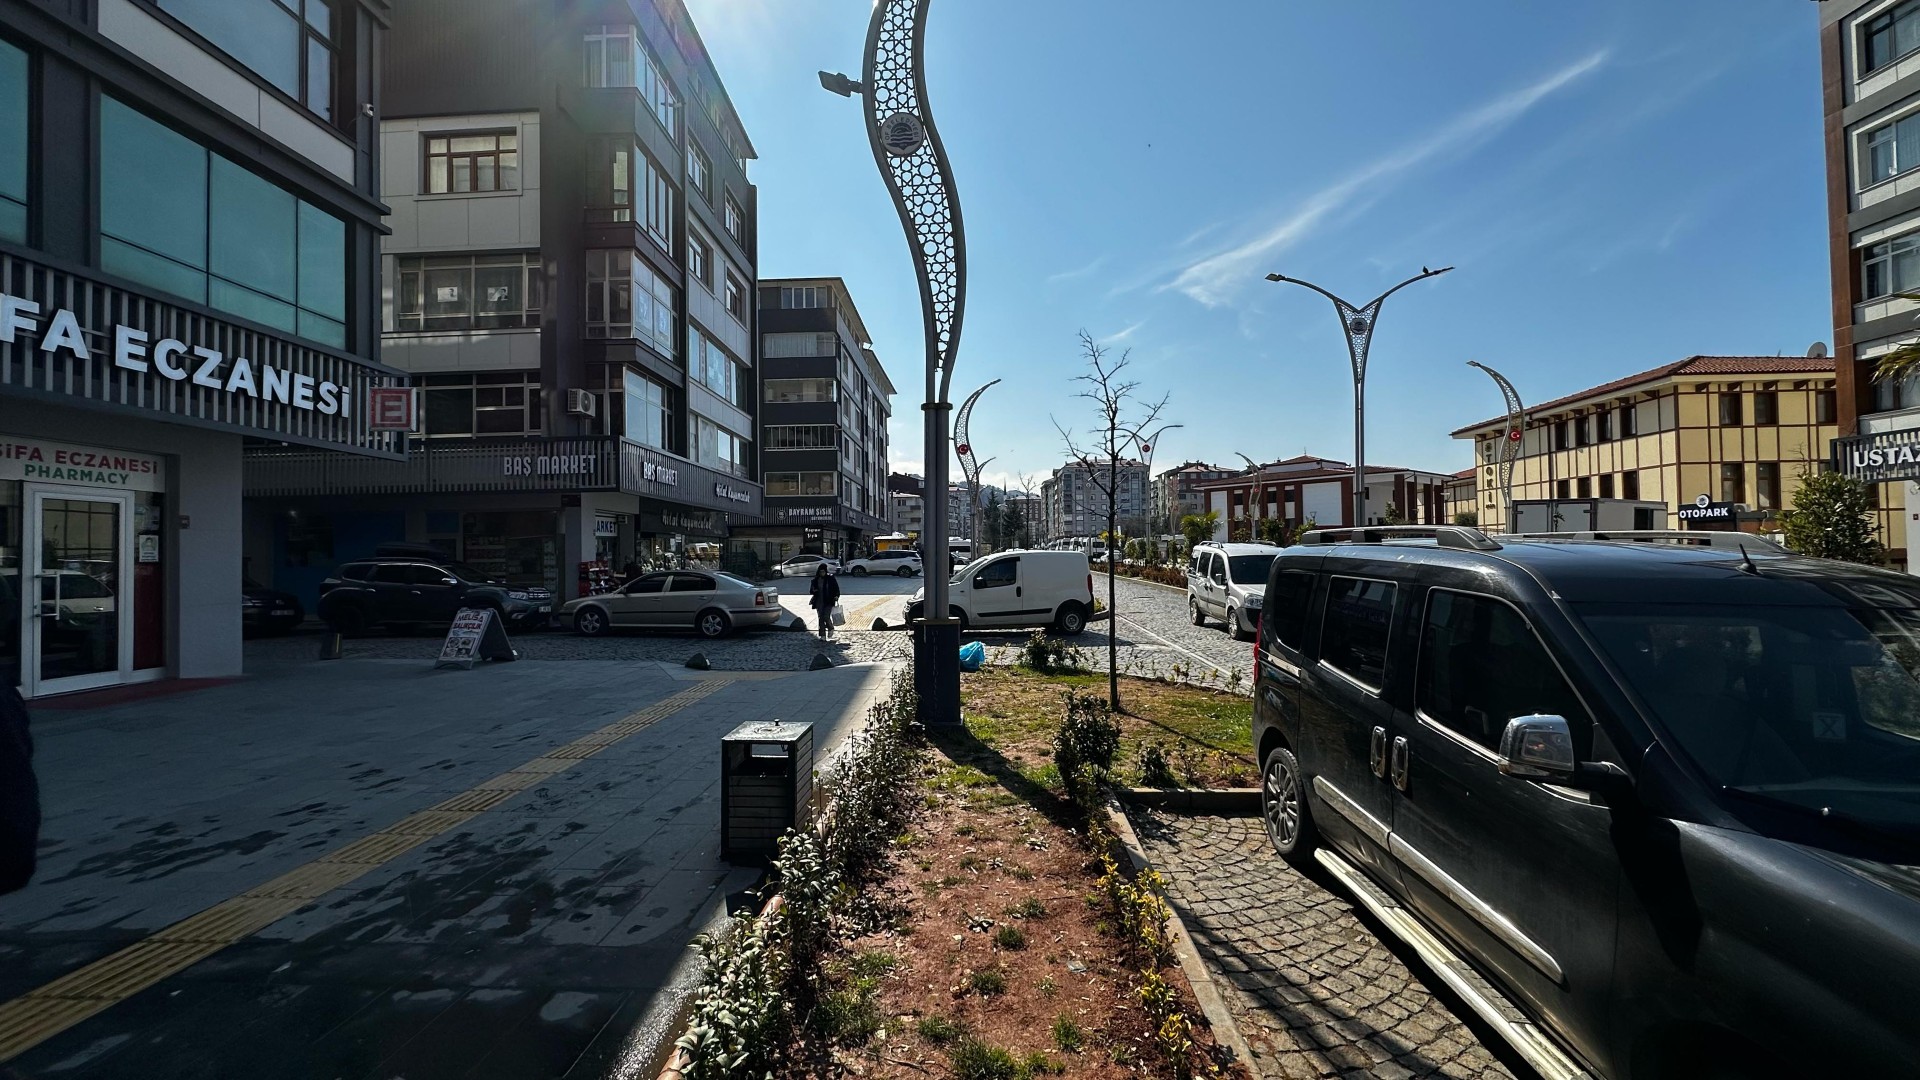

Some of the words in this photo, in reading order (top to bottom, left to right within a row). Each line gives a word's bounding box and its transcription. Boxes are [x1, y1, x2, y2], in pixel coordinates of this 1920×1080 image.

[115, 324, 350, 418] ECZANESİ
[24, 464, 130, 485] PHARMACY
[503, 456, 531, 477] BAŞ
[537, 455, 596, 475] MARKET
[788, 507, 814, 516] BAYRAM
[1679, 507, 1728, 519] OTOPARK
[596, 520, 616, 533] ARKET
